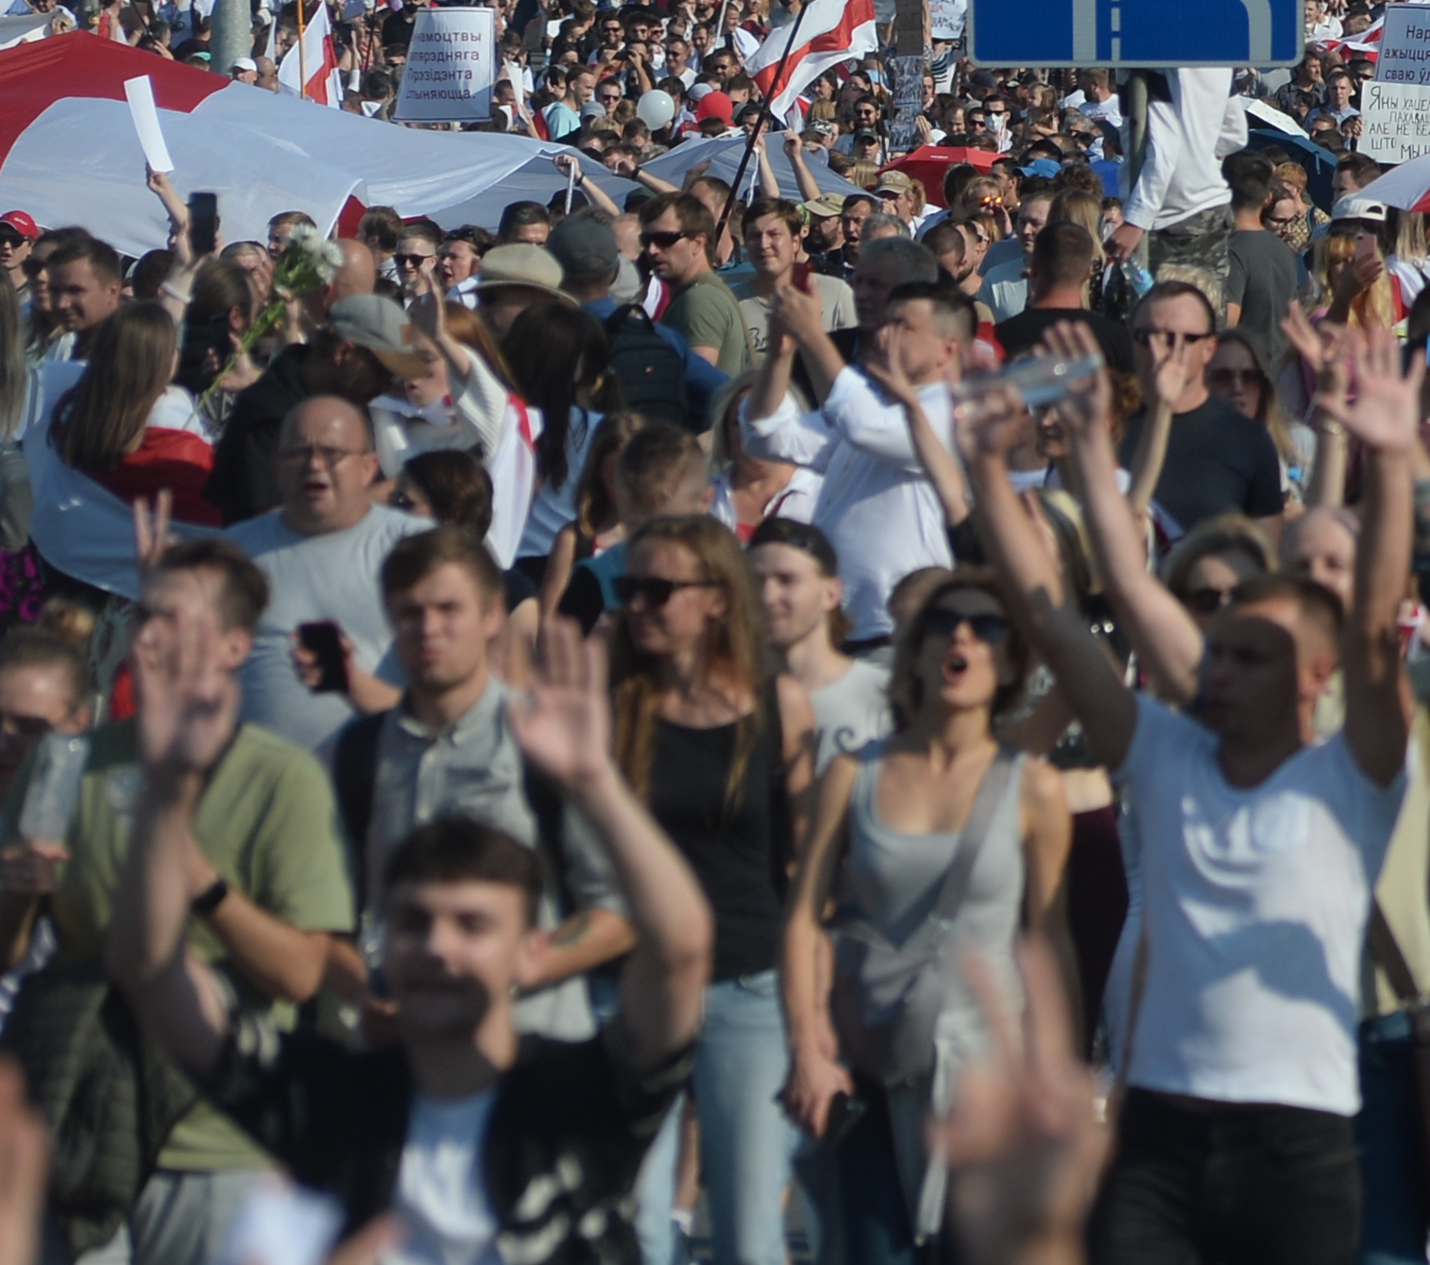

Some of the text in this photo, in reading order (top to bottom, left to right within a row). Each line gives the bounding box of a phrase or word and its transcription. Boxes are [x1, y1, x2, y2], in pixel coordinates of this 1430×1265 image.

[1385, 69, 1415, 81] сваю
[1396, 123, 1410, 136] НЕ
[1371, 137, 1396, 150] ШТО
[1400, 144, 1420, 159] МЫ
